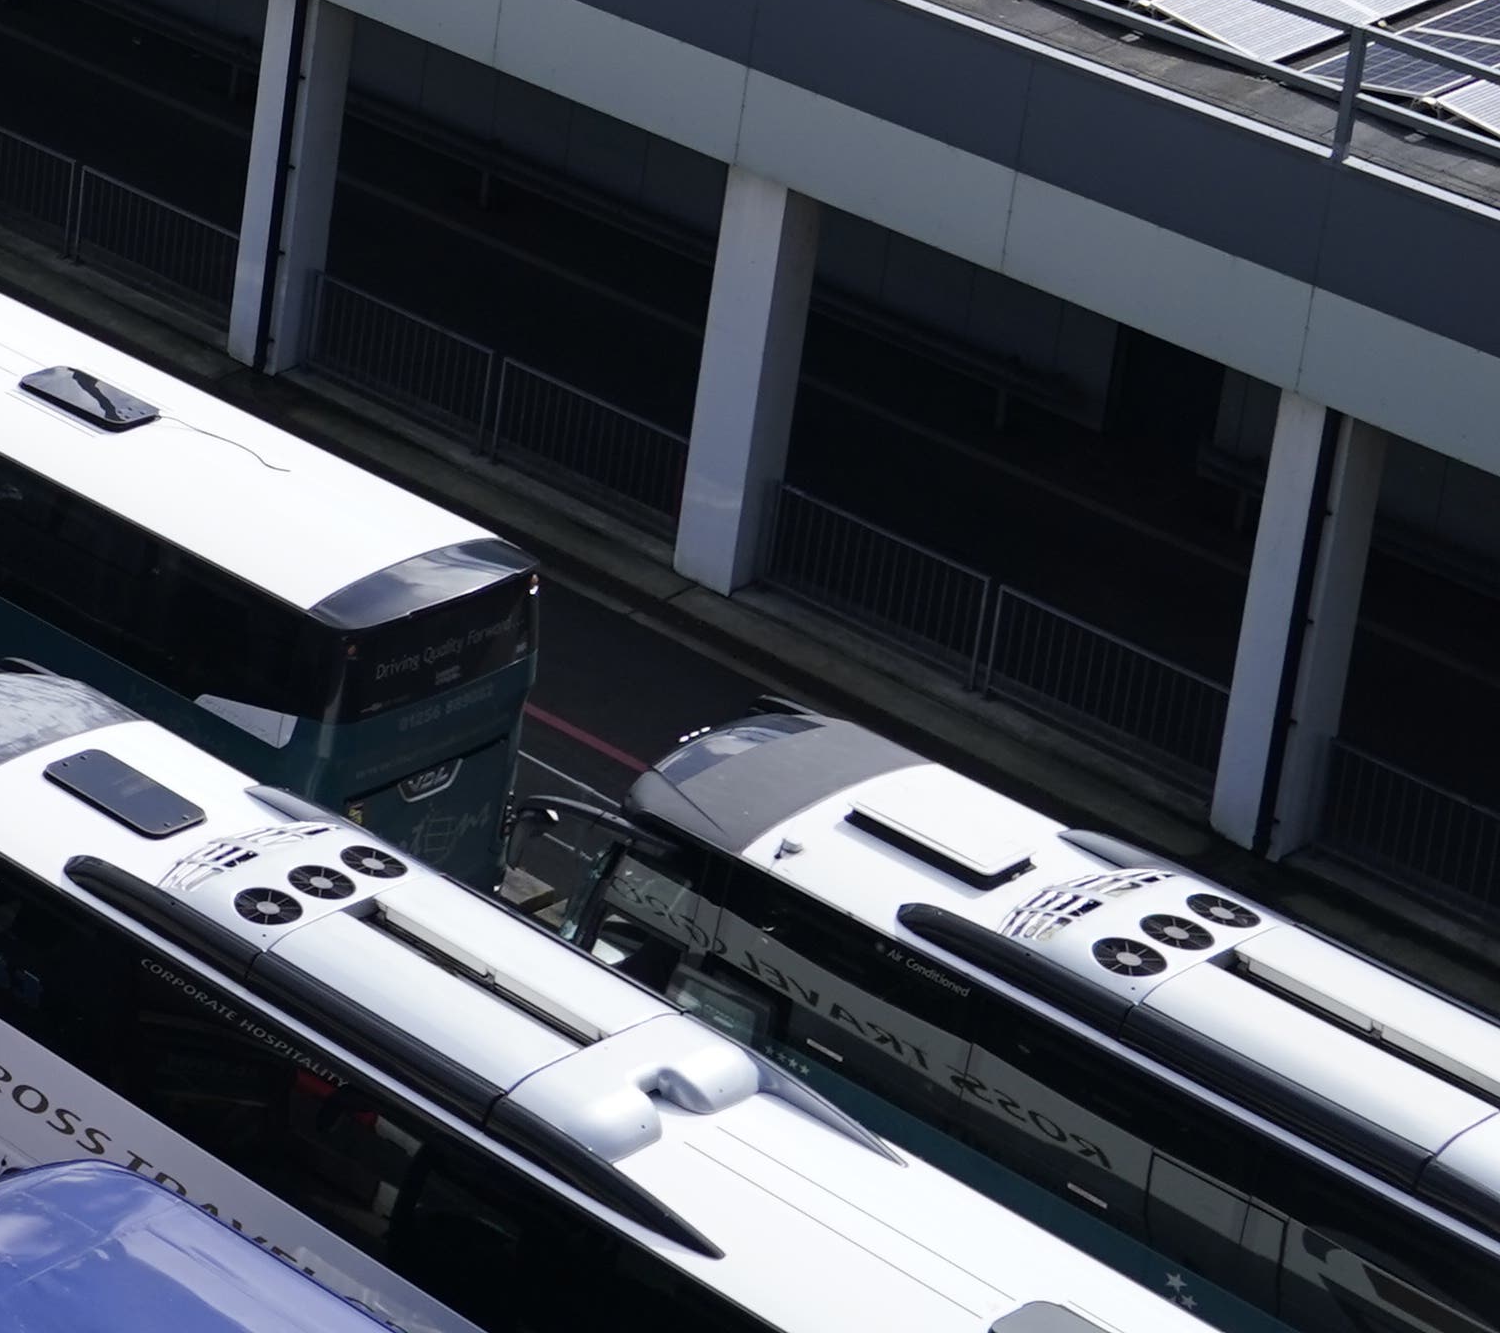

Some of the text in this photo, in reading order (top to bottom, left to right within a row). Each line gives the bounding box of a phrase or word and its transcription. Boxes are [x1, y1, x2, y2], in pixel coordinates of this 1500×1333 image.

[376, 657, 420, 680] Driving
[423, 636, 463, 665] Quality
[408, 765, 450, 791] VDL
[887, 948, 971, 997] Air Conditioned
[141, 955, 349, 1090] CORPORATE HOSPITALITY
